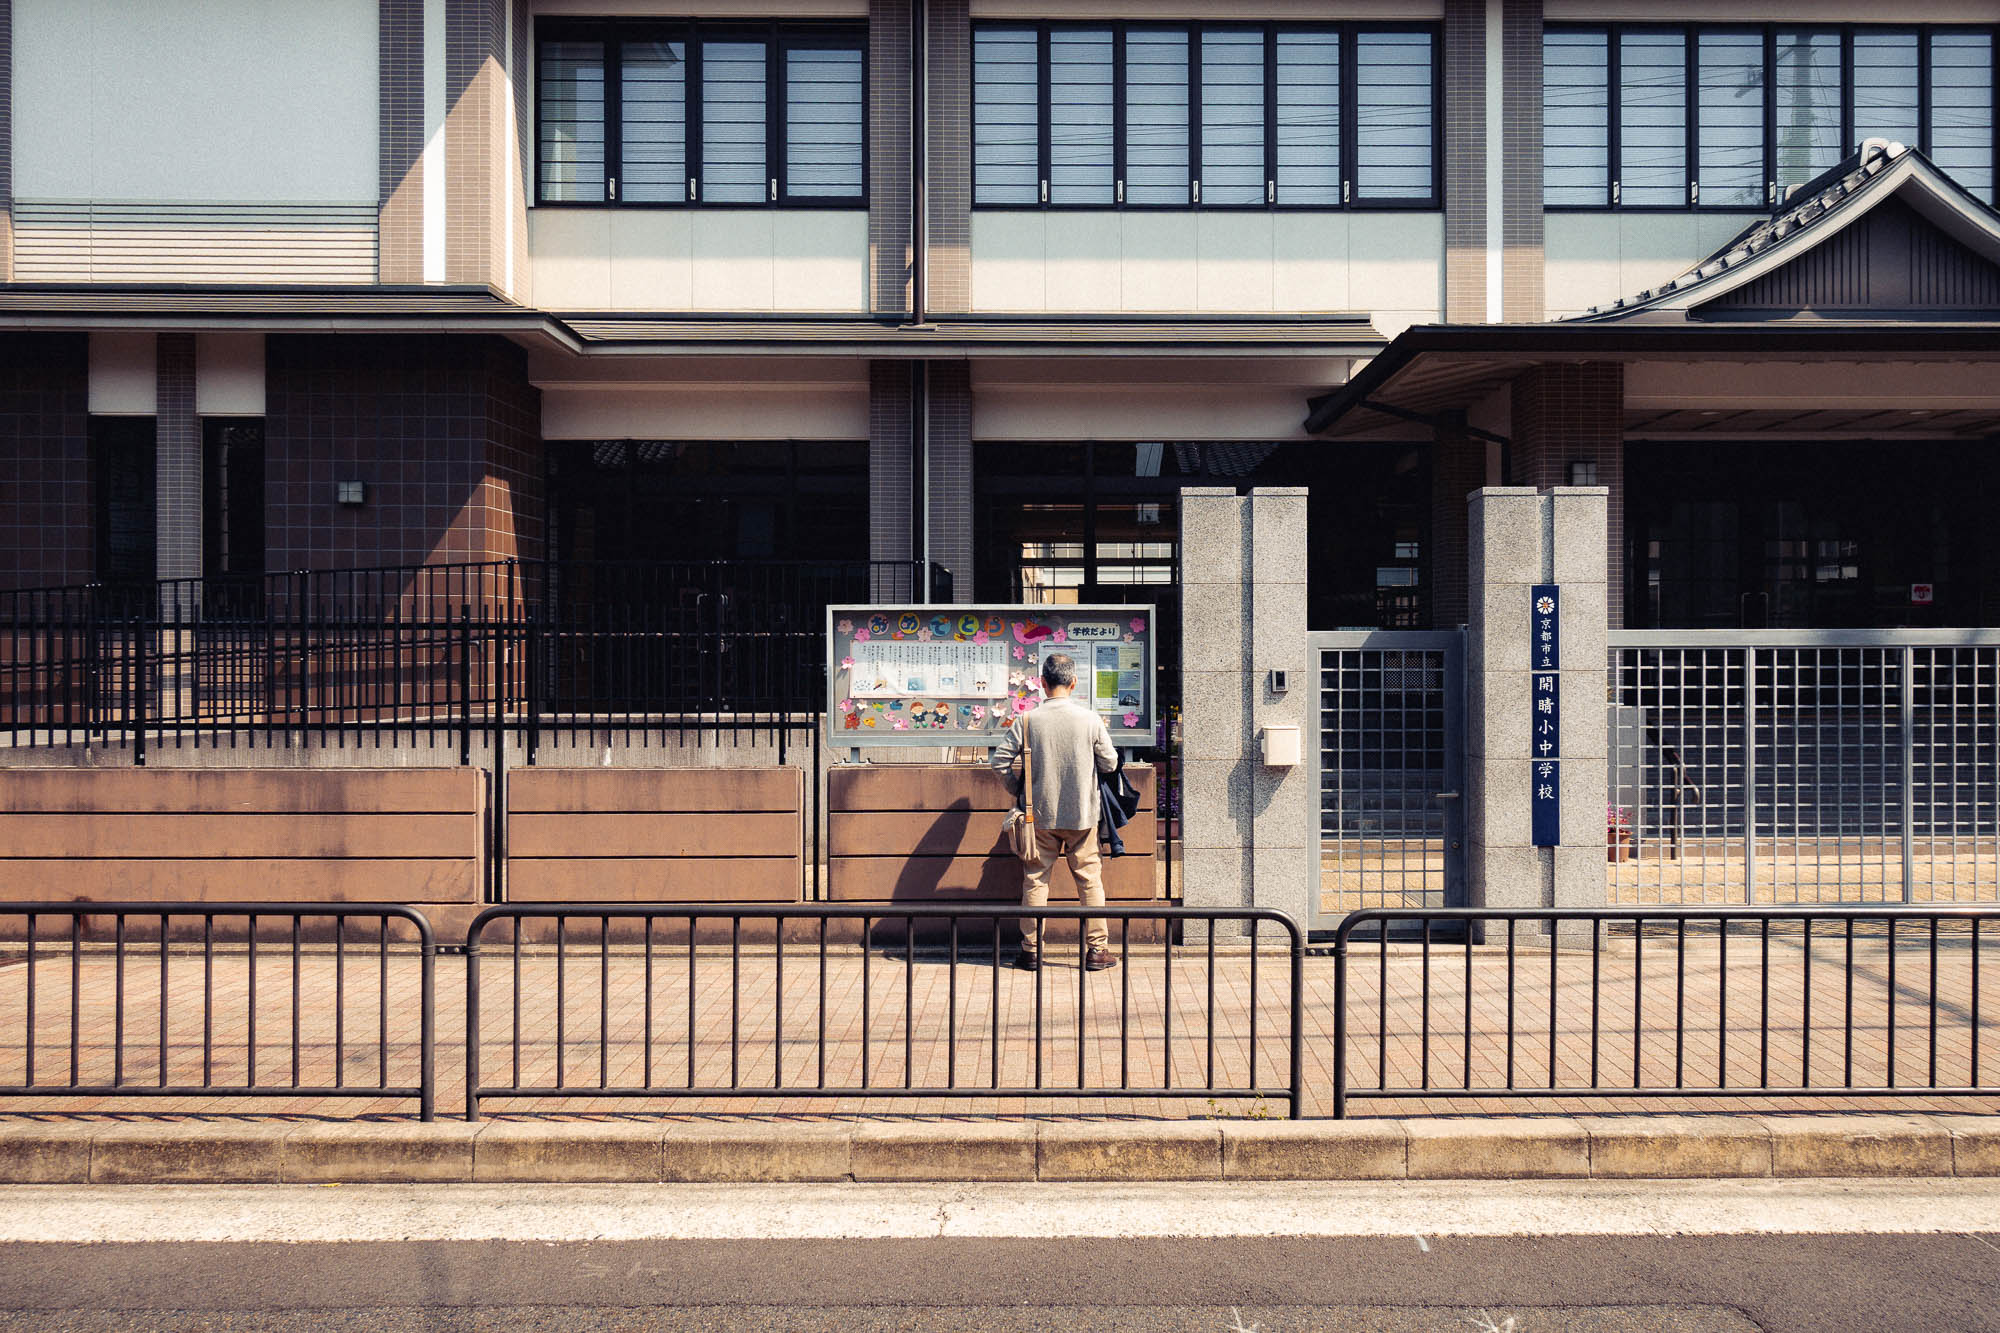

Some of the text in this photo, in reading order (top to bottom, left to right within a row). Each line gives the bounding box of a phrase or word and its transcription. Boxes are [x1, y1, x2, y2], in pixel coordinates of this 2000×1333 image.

[1072, 626, 1115, 636] 学校だより
[1540, 618, 1552, 666] 京都市立
